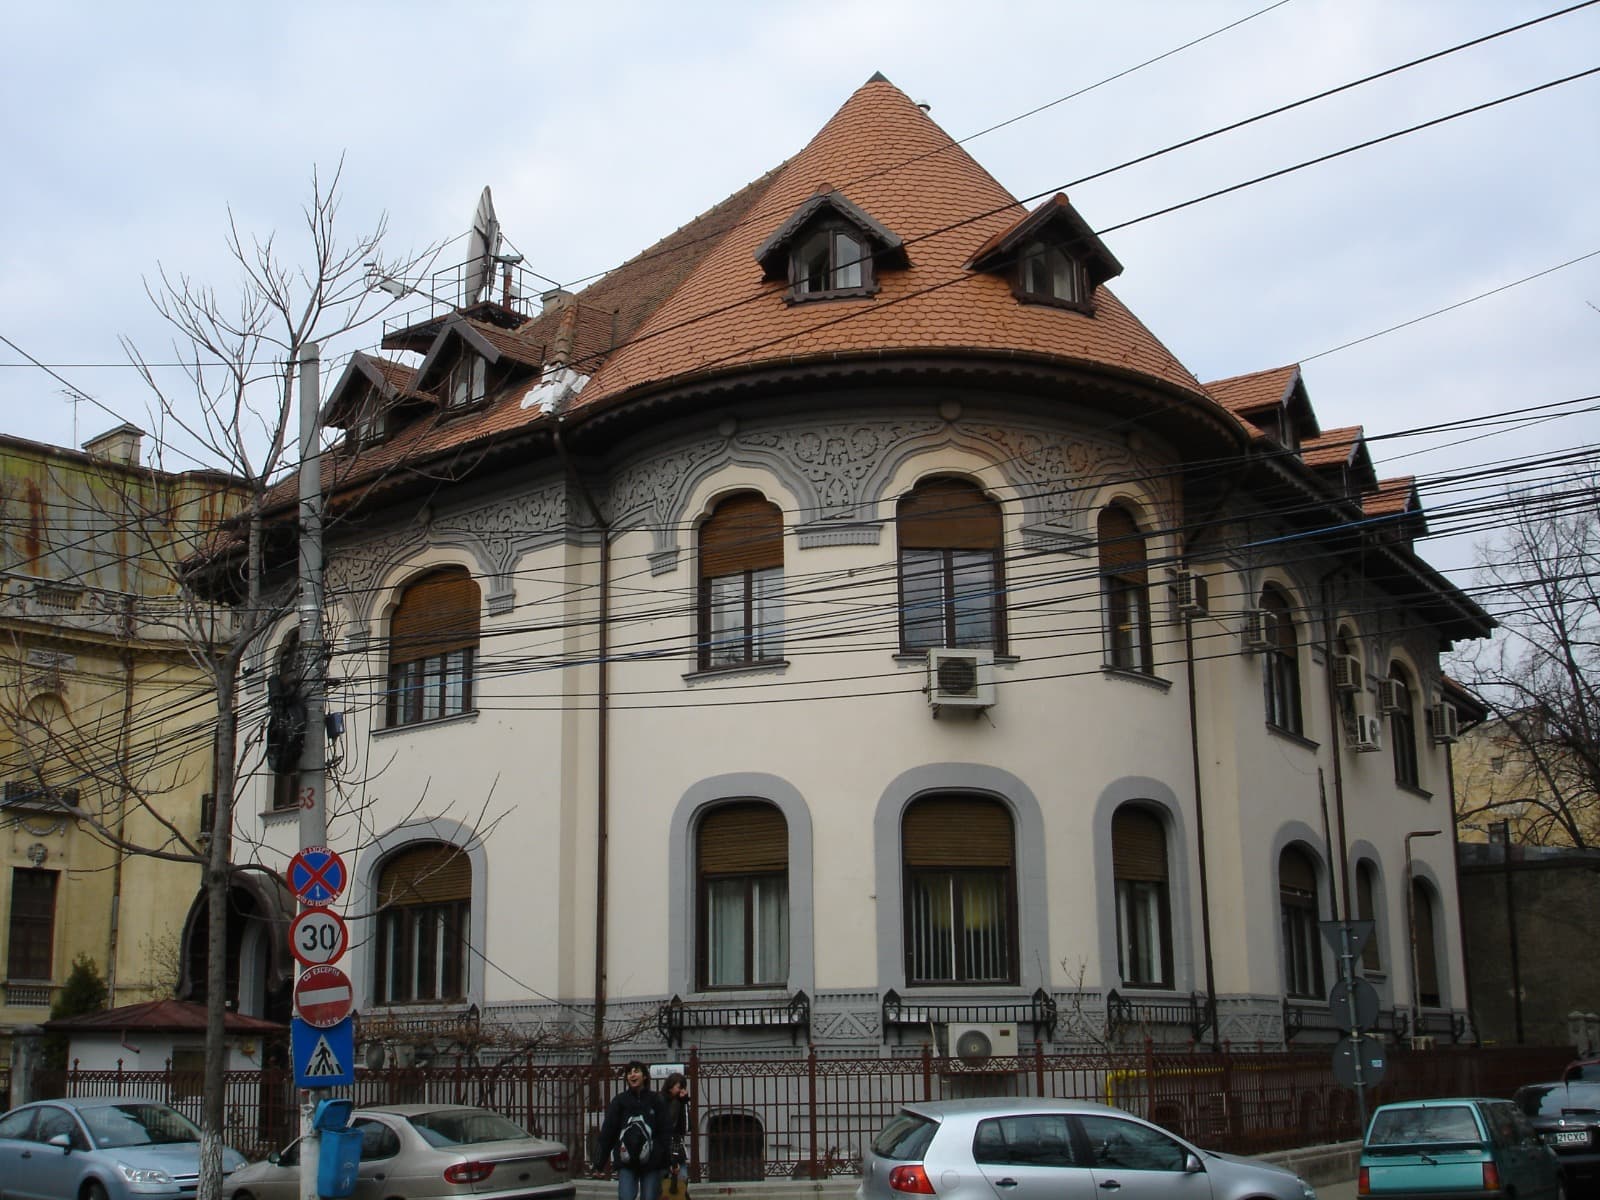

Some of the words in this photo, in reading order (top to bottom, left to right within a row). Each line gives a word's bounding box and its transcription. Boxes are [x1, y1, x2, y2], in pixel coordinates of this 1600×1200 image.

[315, 885, 320, 898] 1
[302, 923, 335, 951] 30
[302, 972, 312, 981] CU
